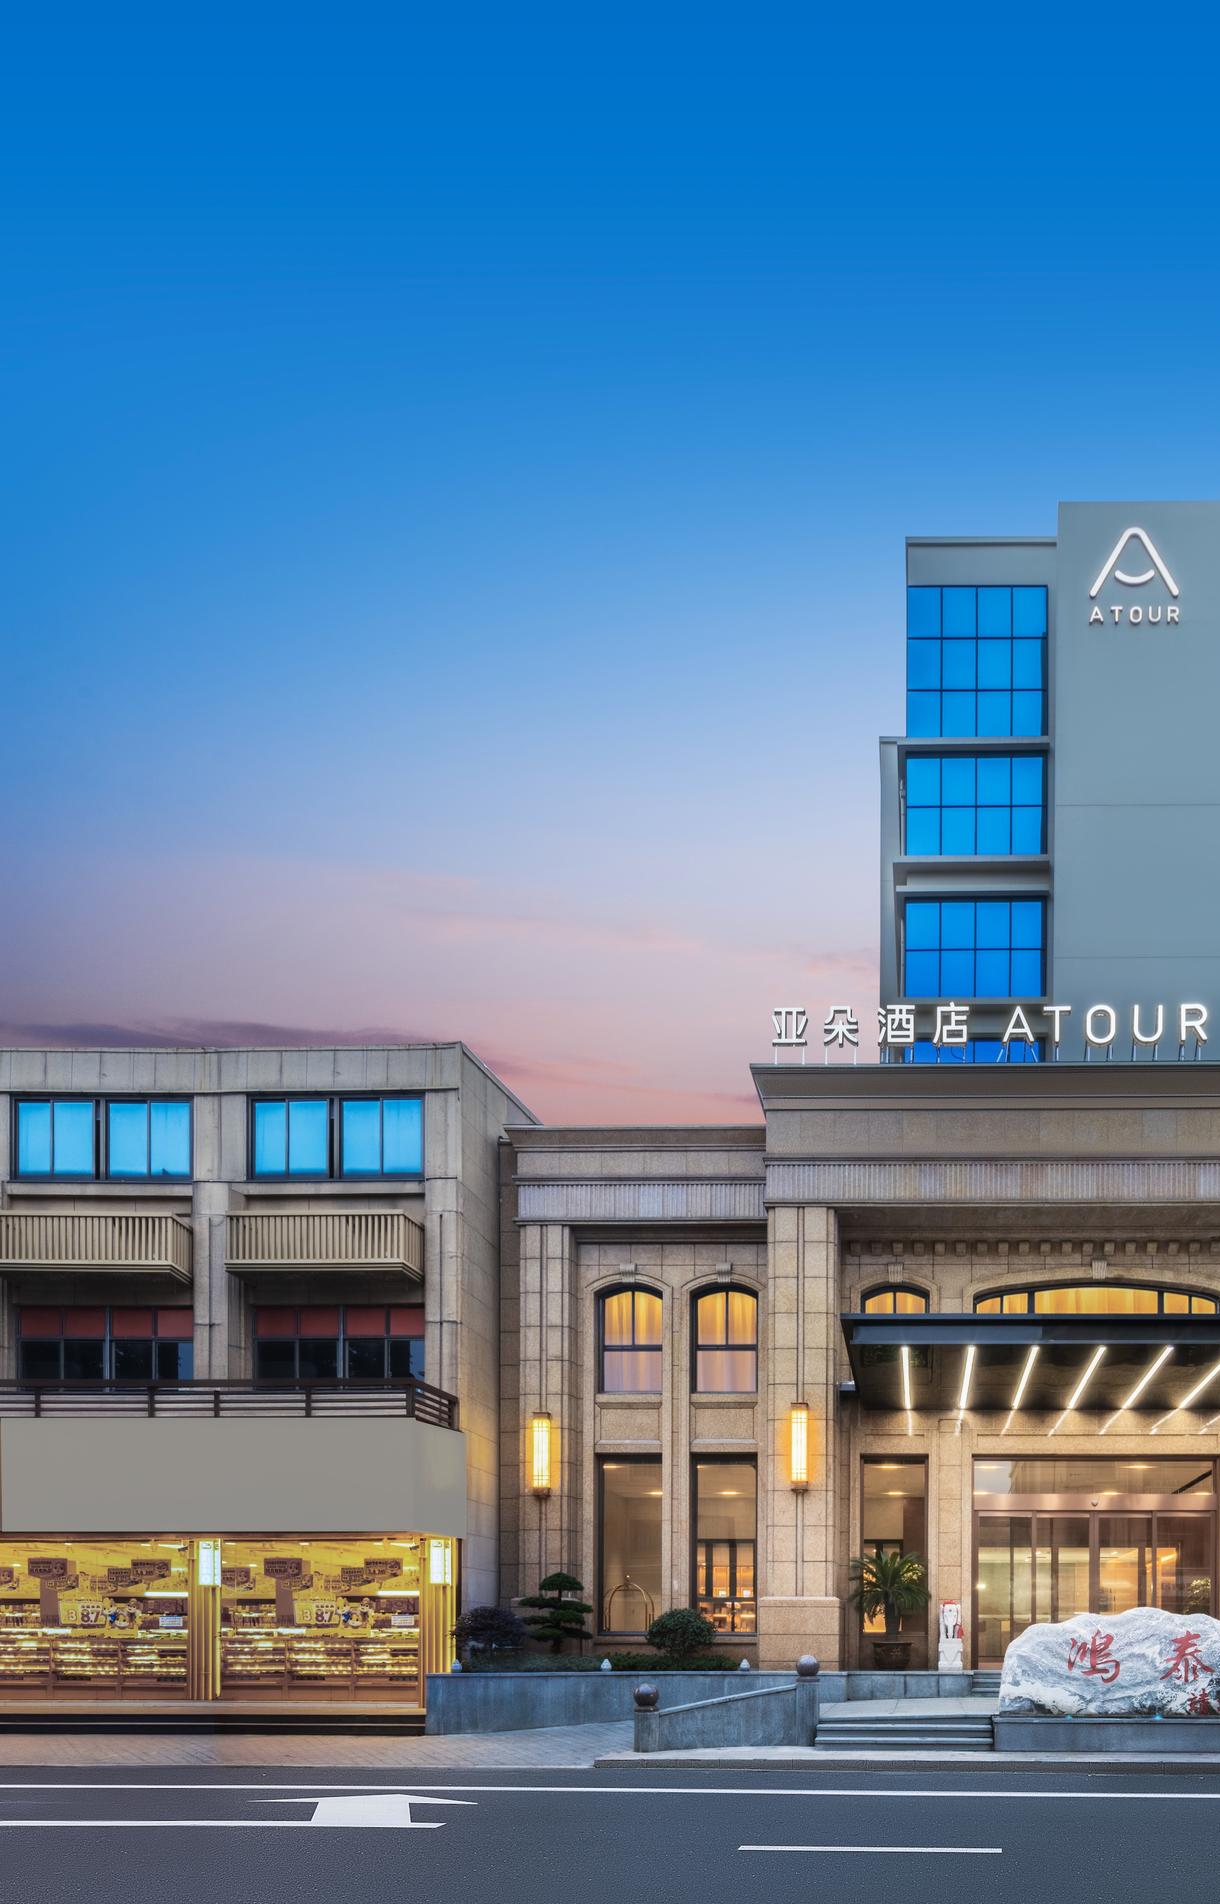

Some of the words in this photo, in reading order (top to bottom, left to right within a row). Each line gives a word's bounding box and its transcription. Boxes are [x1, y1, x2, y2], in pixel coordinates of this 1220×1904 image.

[1088, 605, 1181, 625] ATOUR
[771, 1001, 970, 1047] 亚朵酒店
[1001, 1003, 1209, 1045] ATOUR
[1067, 1629, 1216, 1684] 鸿泰
